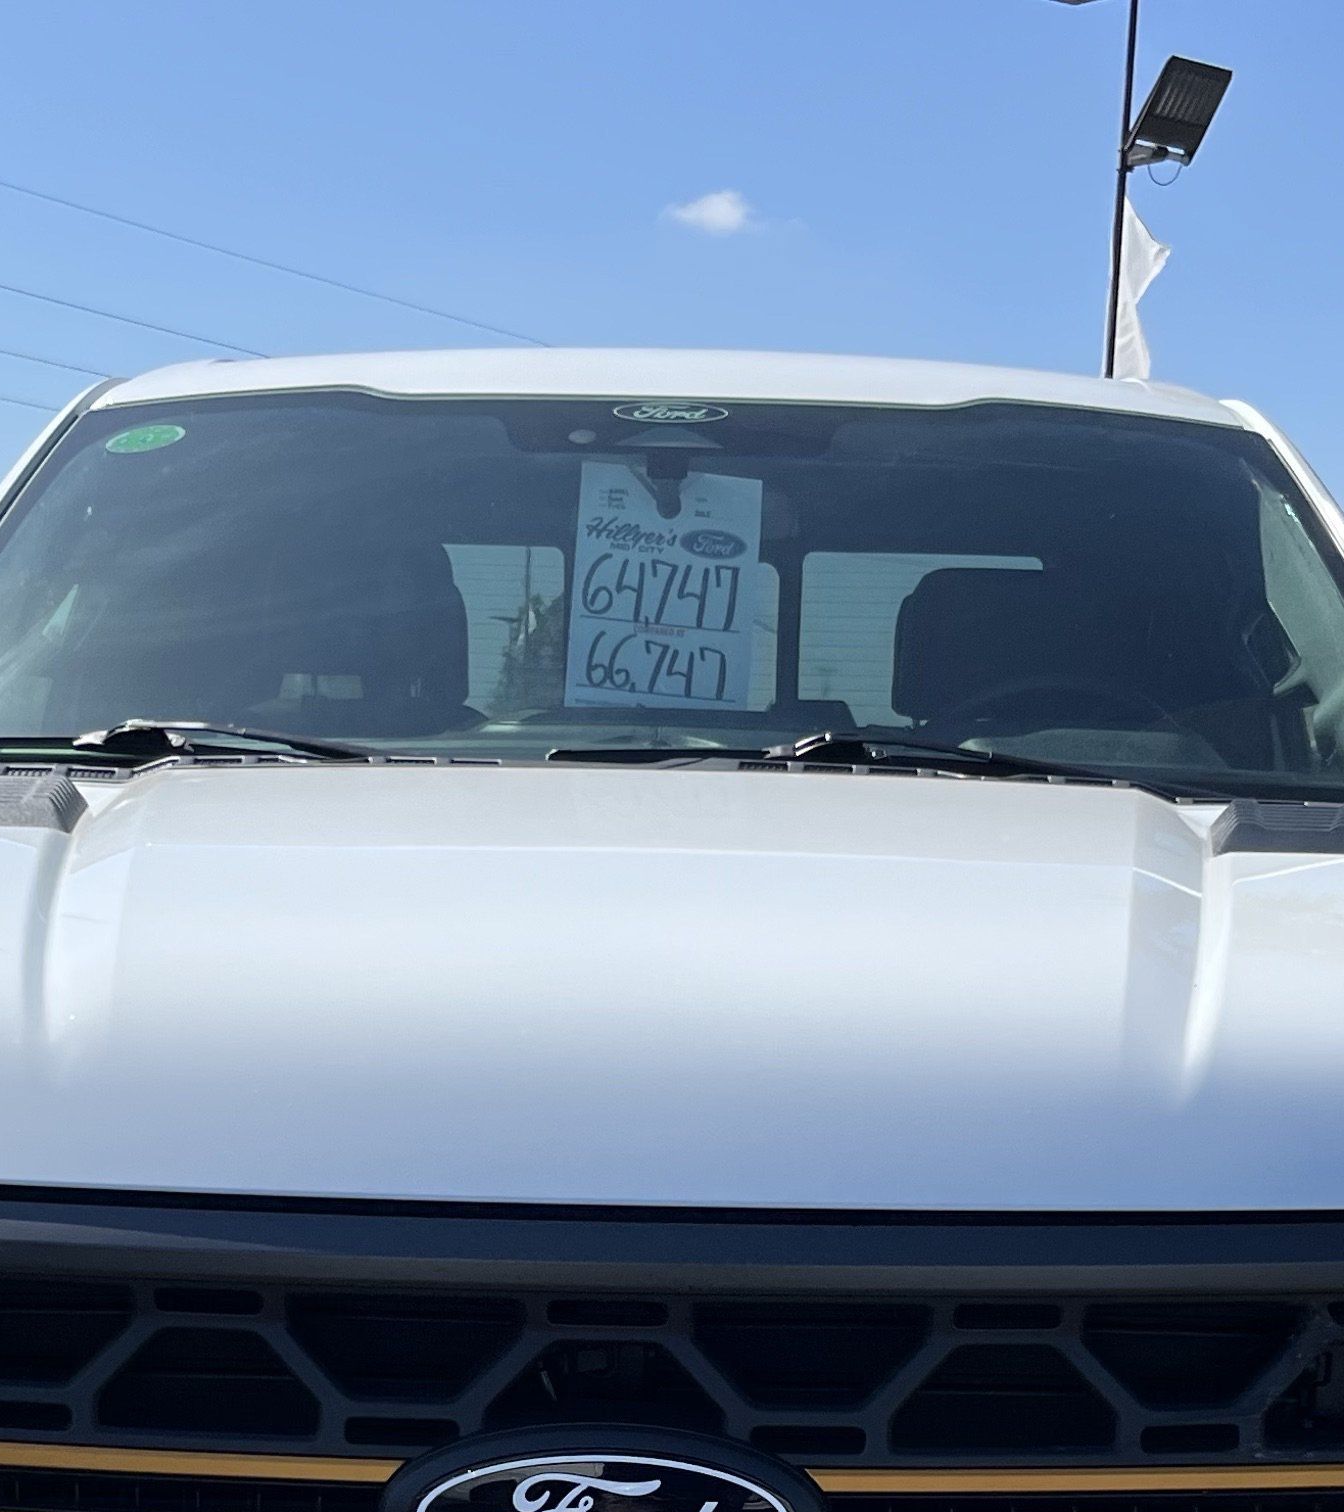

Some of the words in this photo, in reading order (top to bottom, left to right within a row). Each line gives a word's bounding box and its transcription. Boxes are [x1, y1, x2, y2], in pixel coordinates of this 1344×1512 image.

[633, 402, 709, 420] Ford
[586, 516, 678, 548] Hillyer's
[692, 534, 737, 557] Ford
